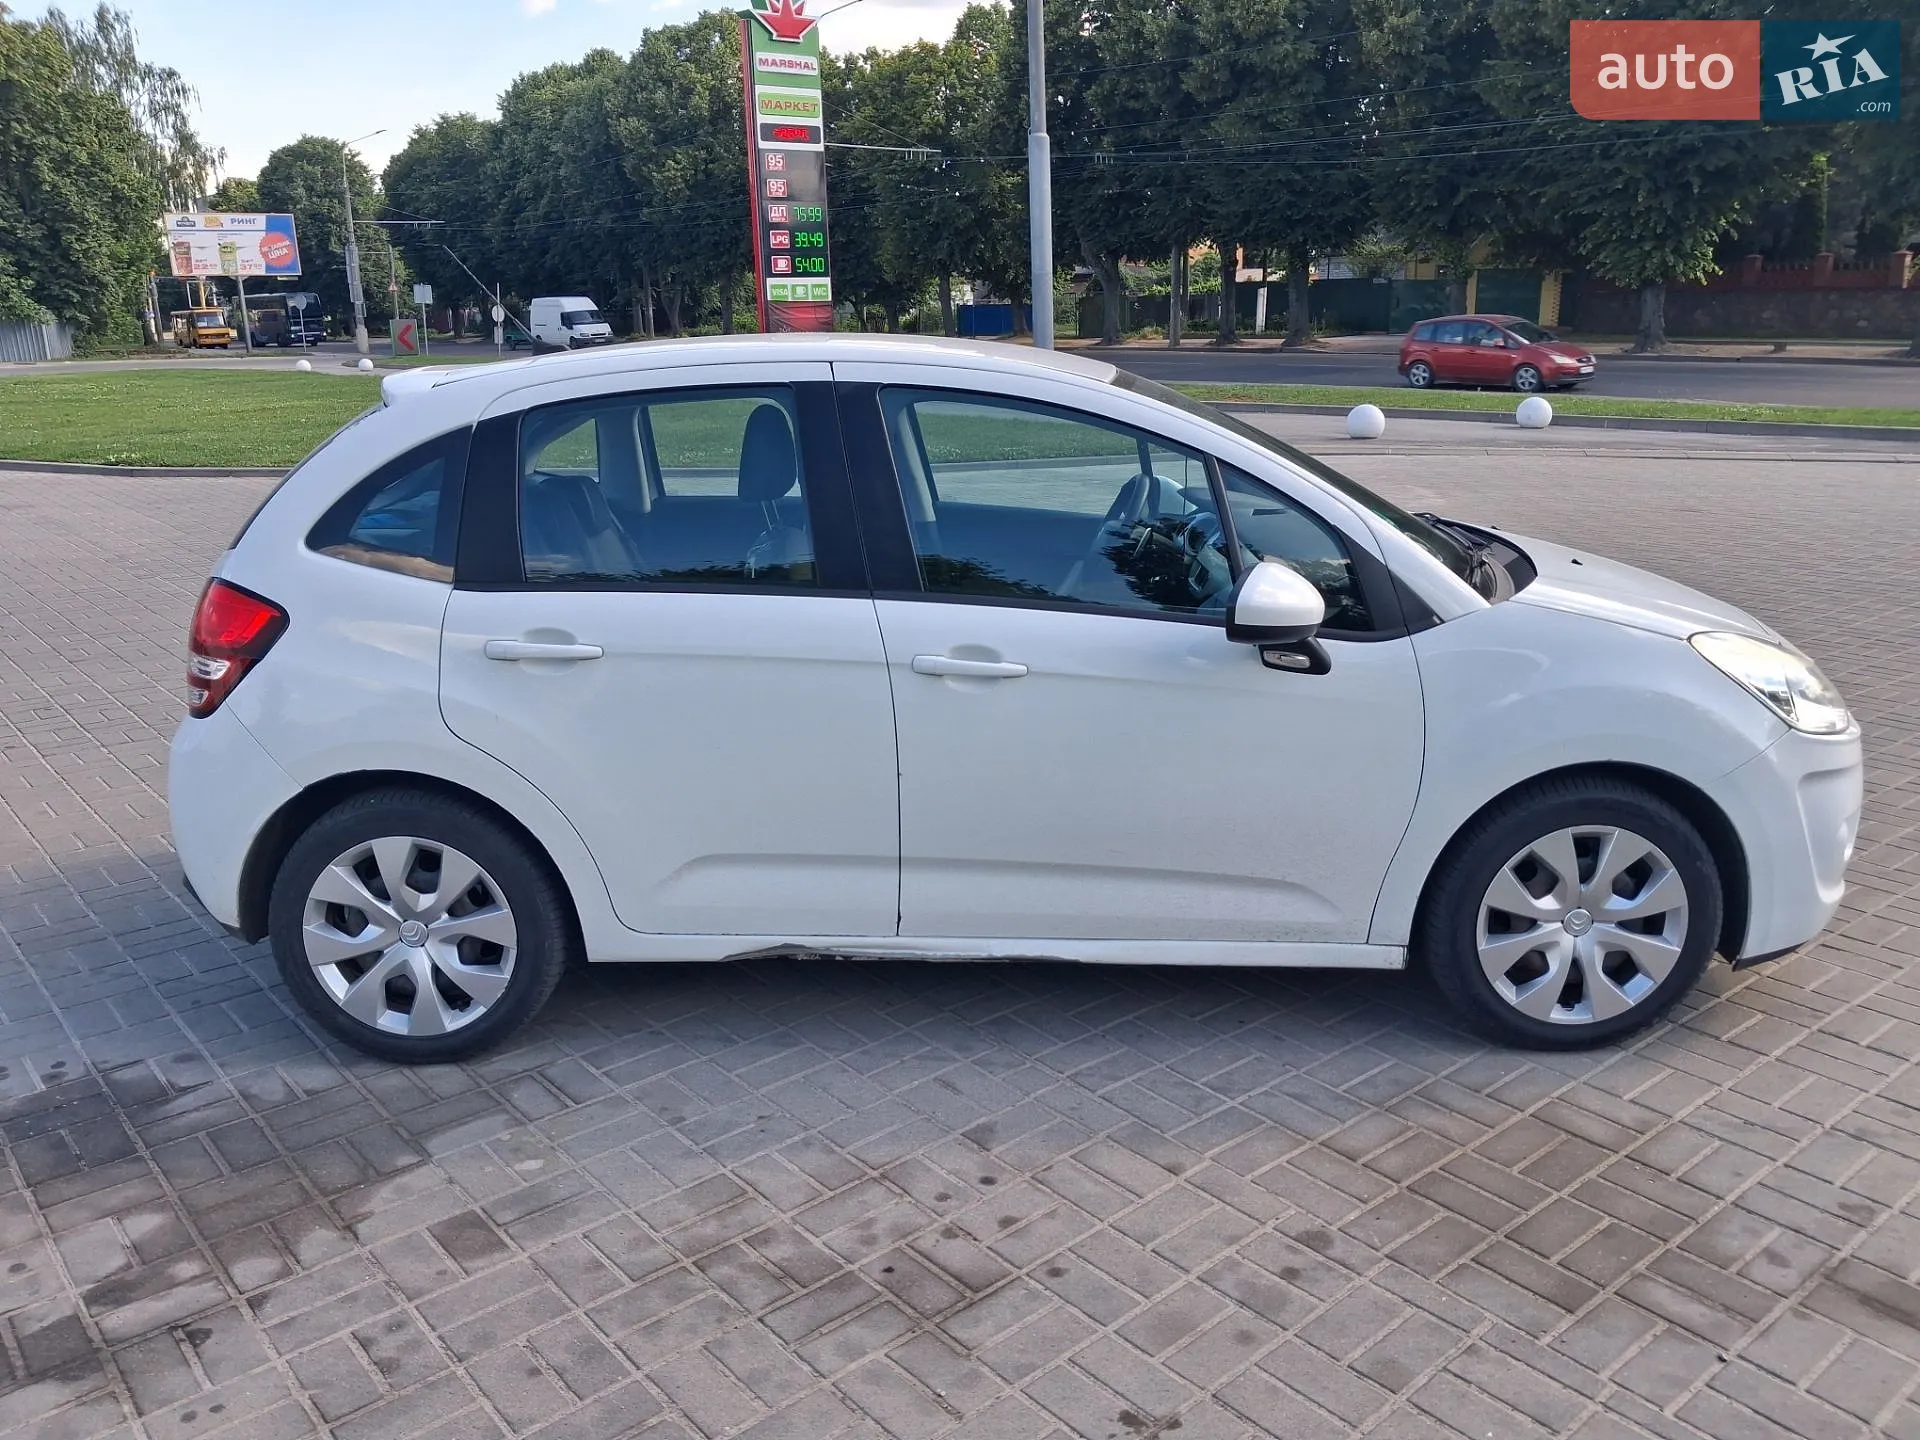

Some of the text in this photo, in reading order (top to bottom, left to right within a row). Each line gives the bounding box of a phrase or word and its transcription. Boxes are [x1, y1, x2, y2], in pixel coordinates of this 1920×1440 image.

[758, 58, 817, 71] MARSHAL
[767, 155, 784, 167] 95
[769, 182, 785, 193] 95
[771, 206, 787, 217] ДП
[230, 217, 257, 225] РИНГ
[772, 232, 824, 248] LPG 39.49
[813, 287, 828, 296] WC
